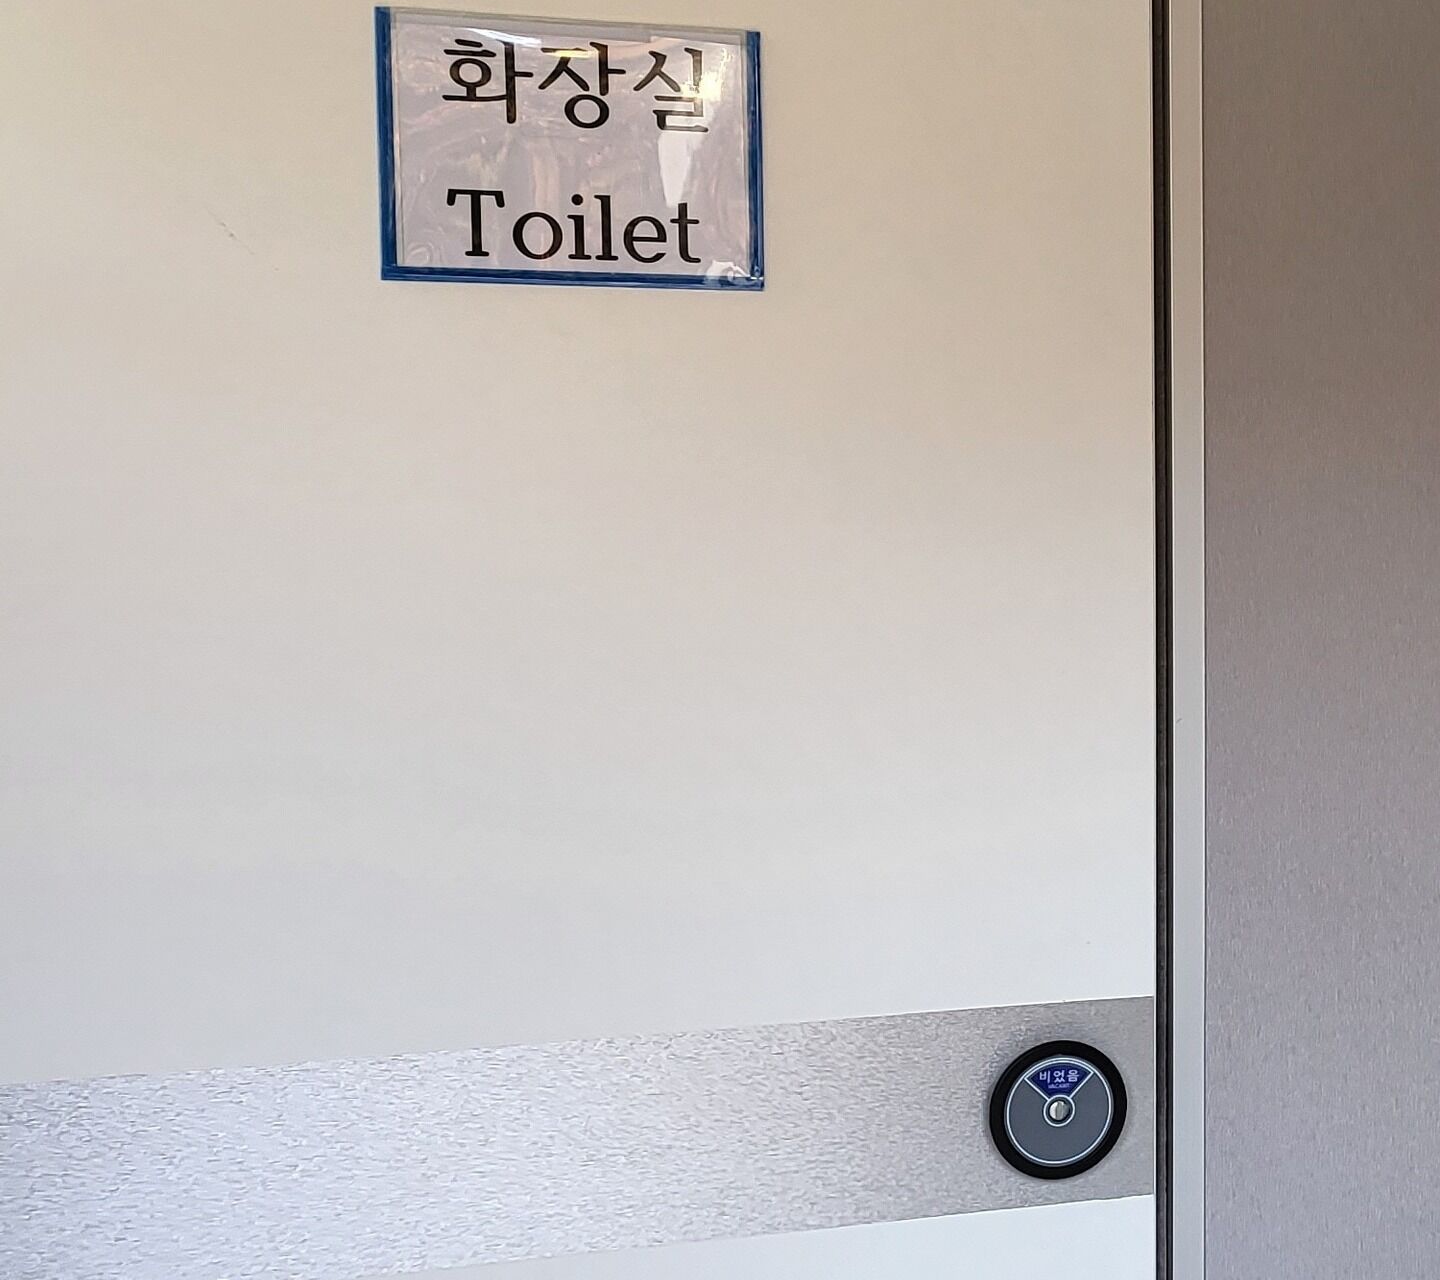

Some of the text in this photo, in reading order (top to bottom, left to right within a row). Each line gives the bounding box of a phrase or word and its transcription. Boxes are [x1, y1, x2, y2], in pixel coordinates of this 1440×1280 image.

[441, 38, 709, 133] 화장실
[446, 187, 702, 264] Toilet
[1039, 1069, 1080, 1084] 비었음
